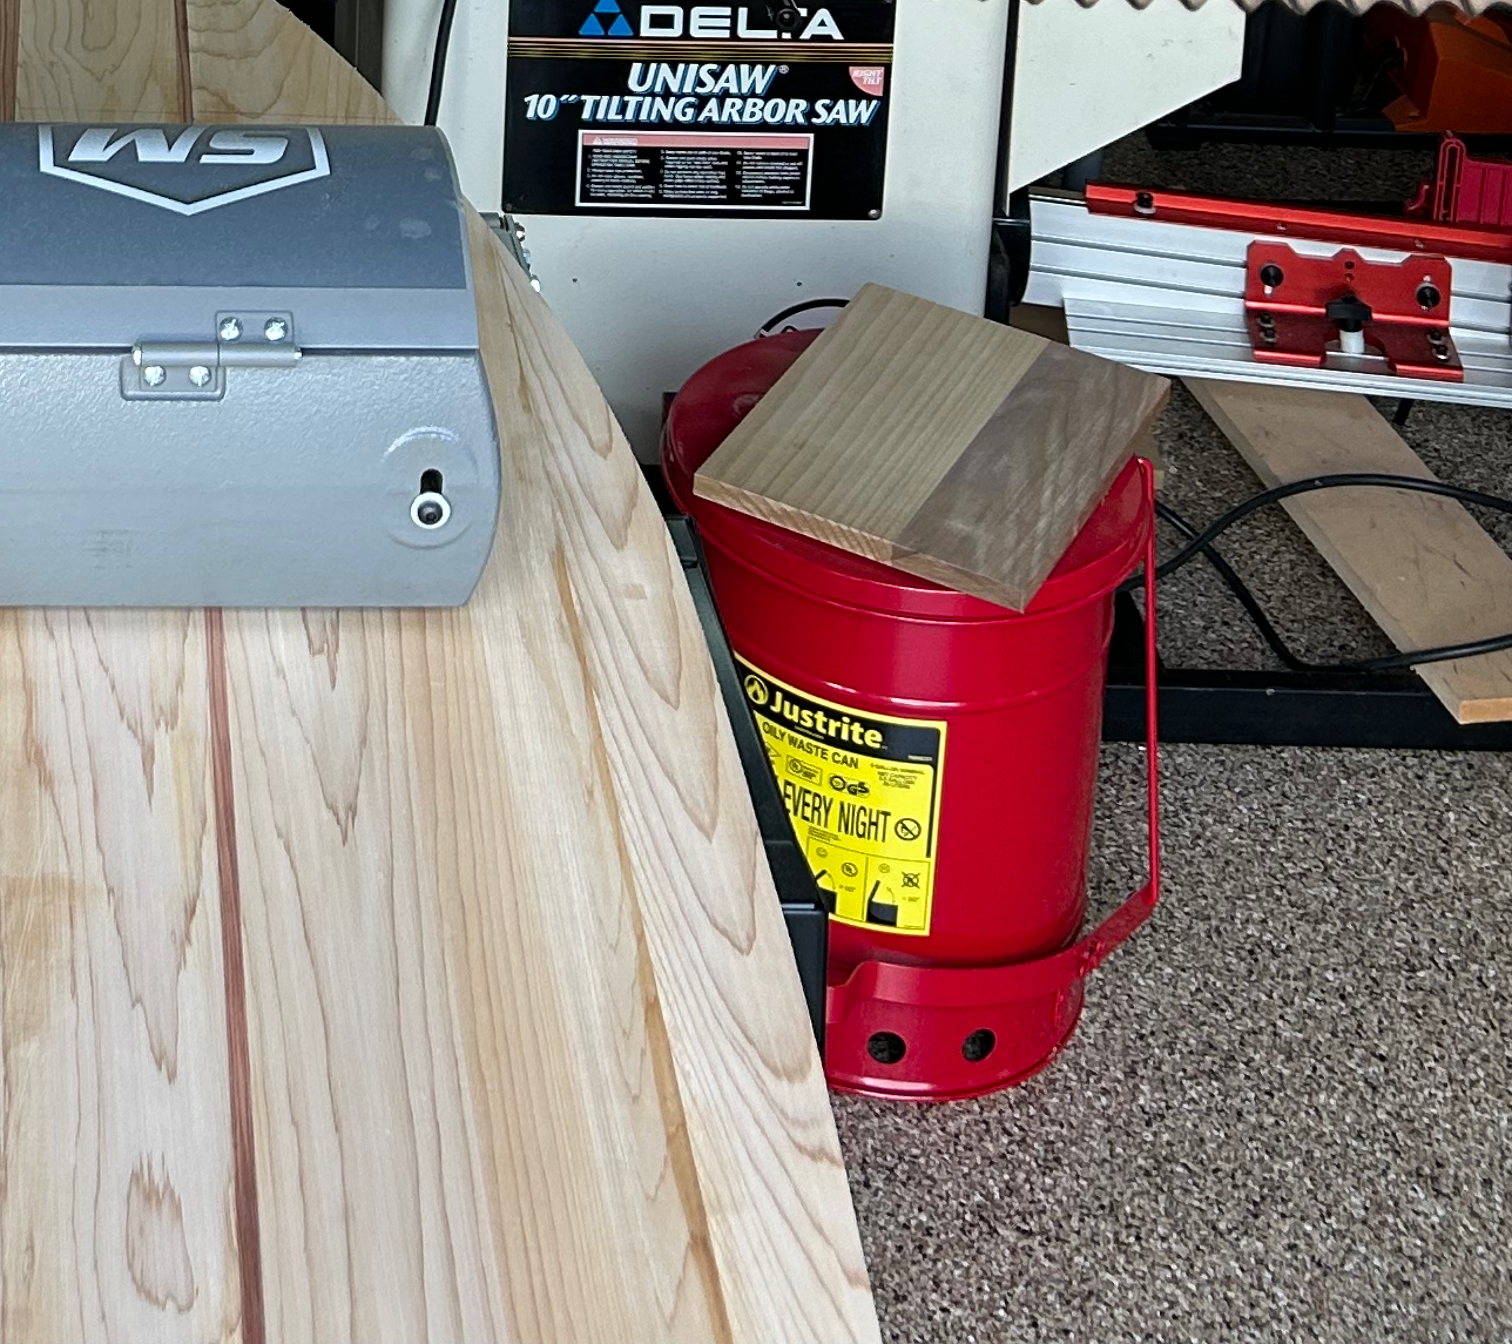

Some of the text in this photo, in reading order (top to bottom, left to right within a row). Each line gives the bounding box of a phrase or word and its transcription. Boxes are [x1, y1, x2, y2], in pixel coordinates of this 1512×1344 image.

[640, 5, 844, 40] DELA
[580, 94, 696, 123] TILTING
[697, 97, 808, 125] ARBOR
[811, 99, 879, 125] SAW
[769, 690, 884, 750] Justrite
[787, 731, 830, 761] WASTE
[831, 752, 859, 770] CAN
[783, 780, 893, 844] EVERY NIGHT
